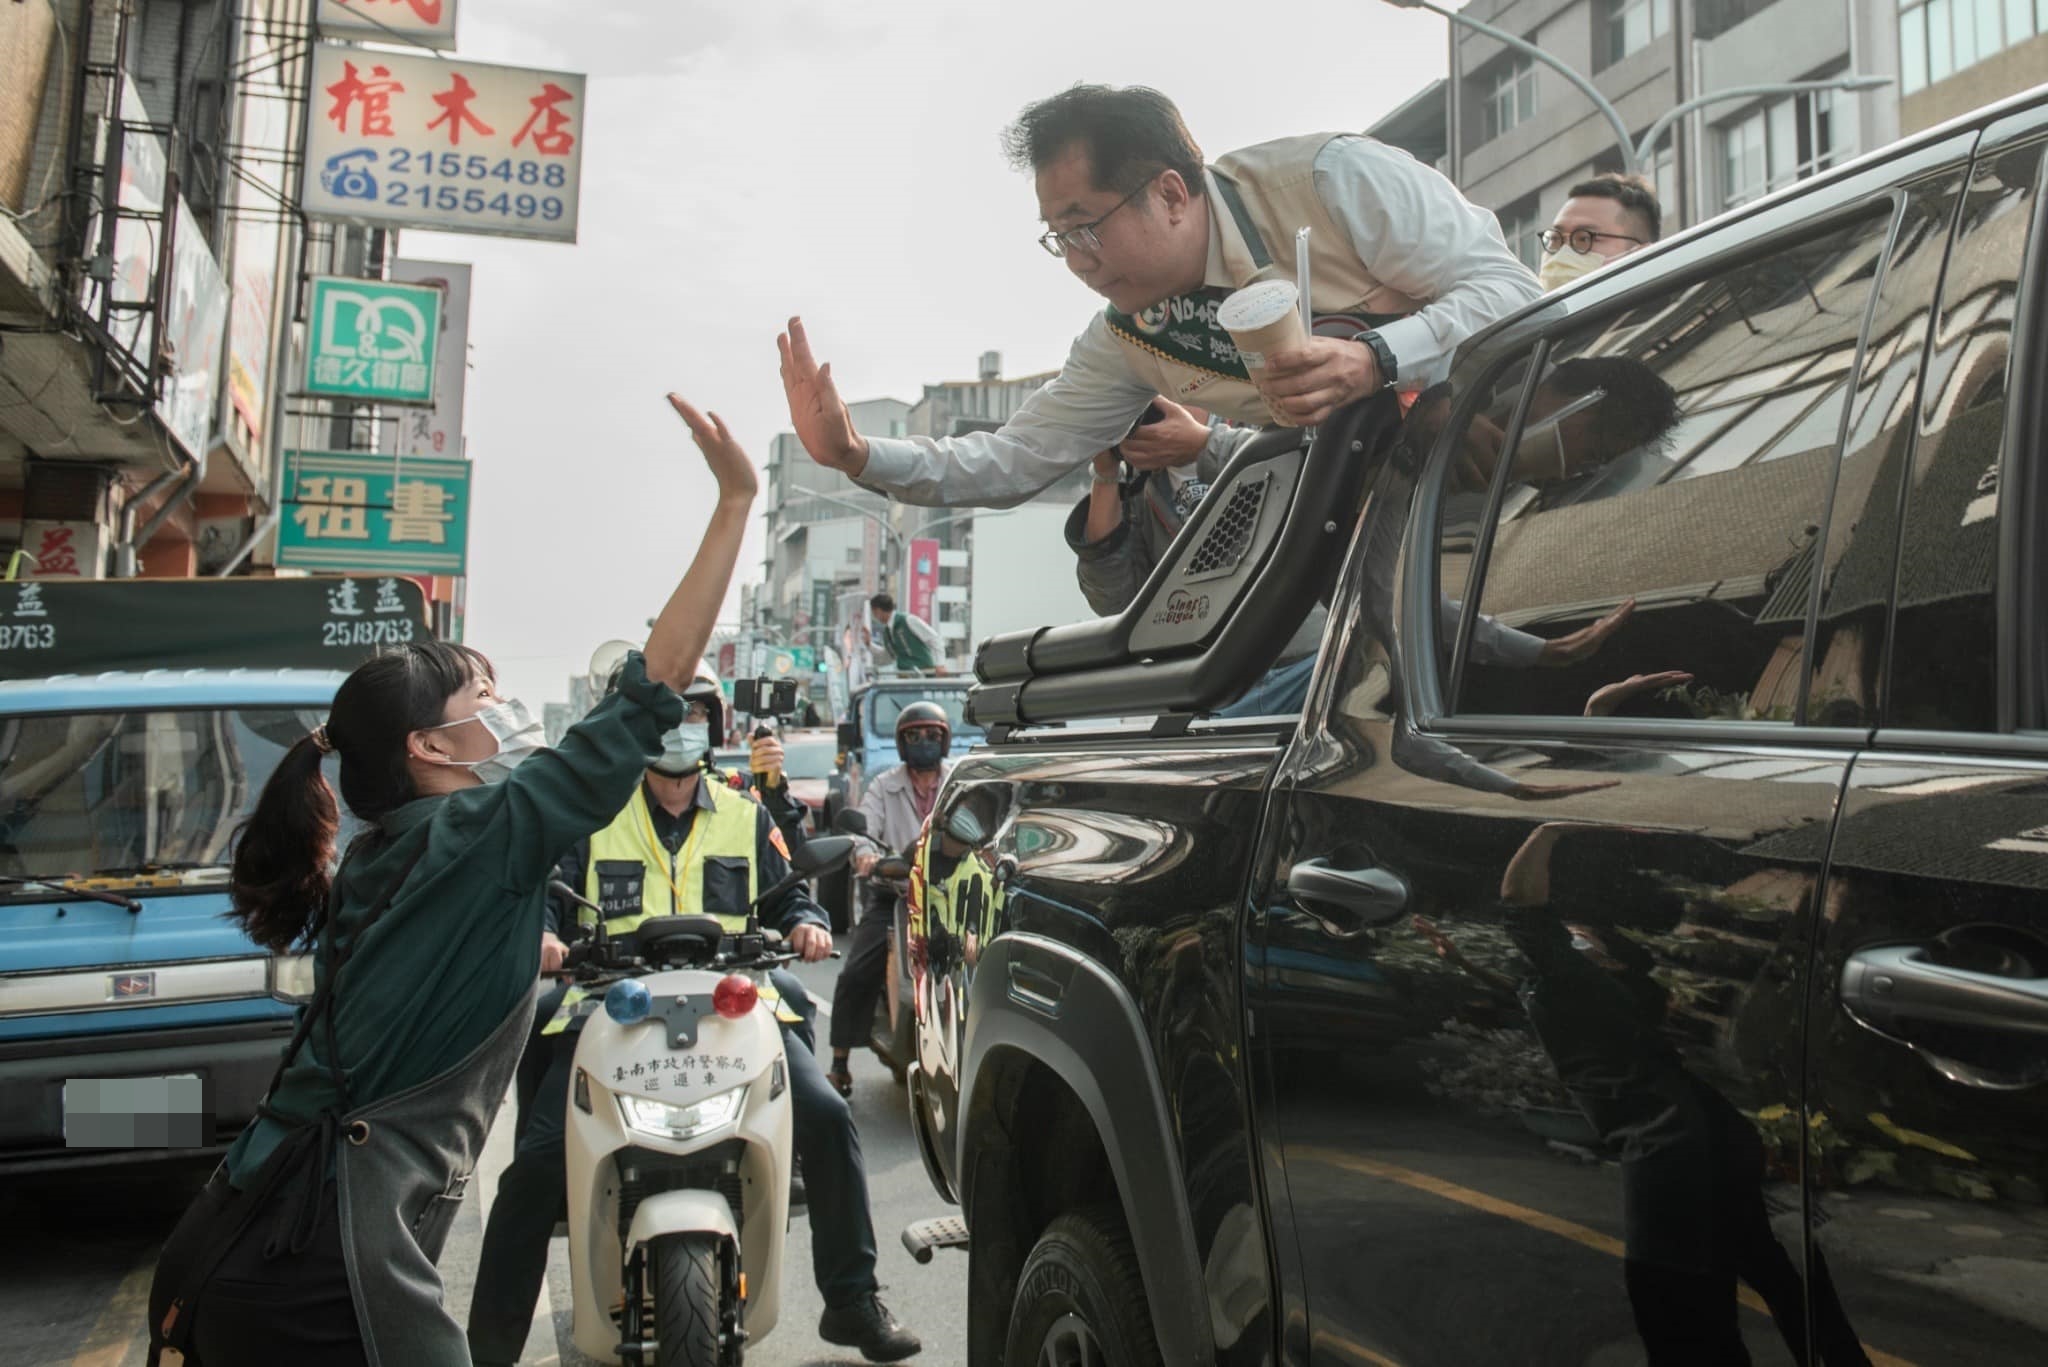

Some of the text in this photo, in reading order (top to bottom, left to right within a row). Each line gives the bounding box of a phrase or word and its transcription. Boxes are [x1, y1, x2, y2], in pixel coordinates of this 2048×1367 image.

[325, 59, 575, 156] 棺木店
[388, 148, 567, 188] 2155488
[386, 181, 564, 222] 2155499
[319, 289, 427, 364] D&Q
[293, 476, 456, 544] 租書
[327, 578, 405, 616] 達益
